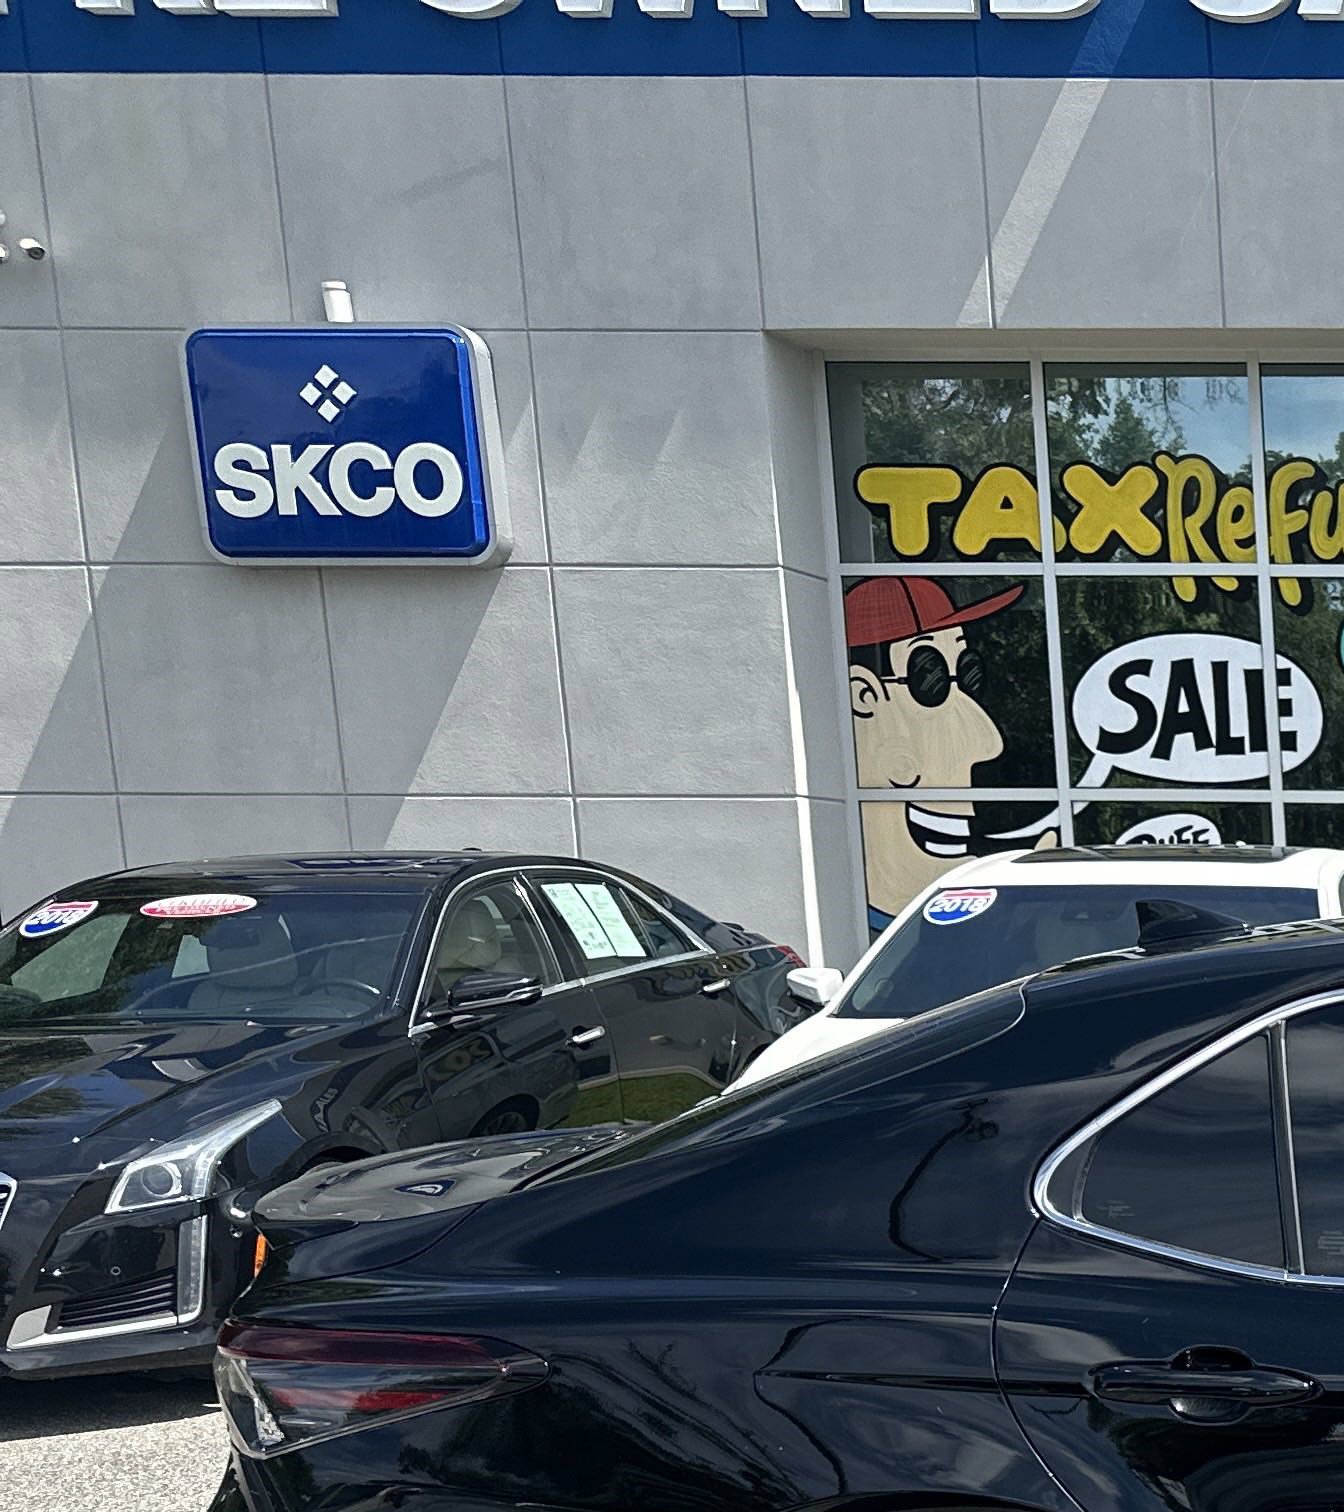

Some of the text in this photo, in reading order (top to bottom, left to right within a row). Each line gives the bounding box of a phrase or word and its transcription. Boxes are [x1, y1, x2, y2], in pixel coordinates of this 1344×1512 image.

[213, 441, 464, 519] SKCO
[855, 463, 1164, 557] TAX
[1096, 656, 1299, 761] SALE
[931, 897, 991, 914] 2018
